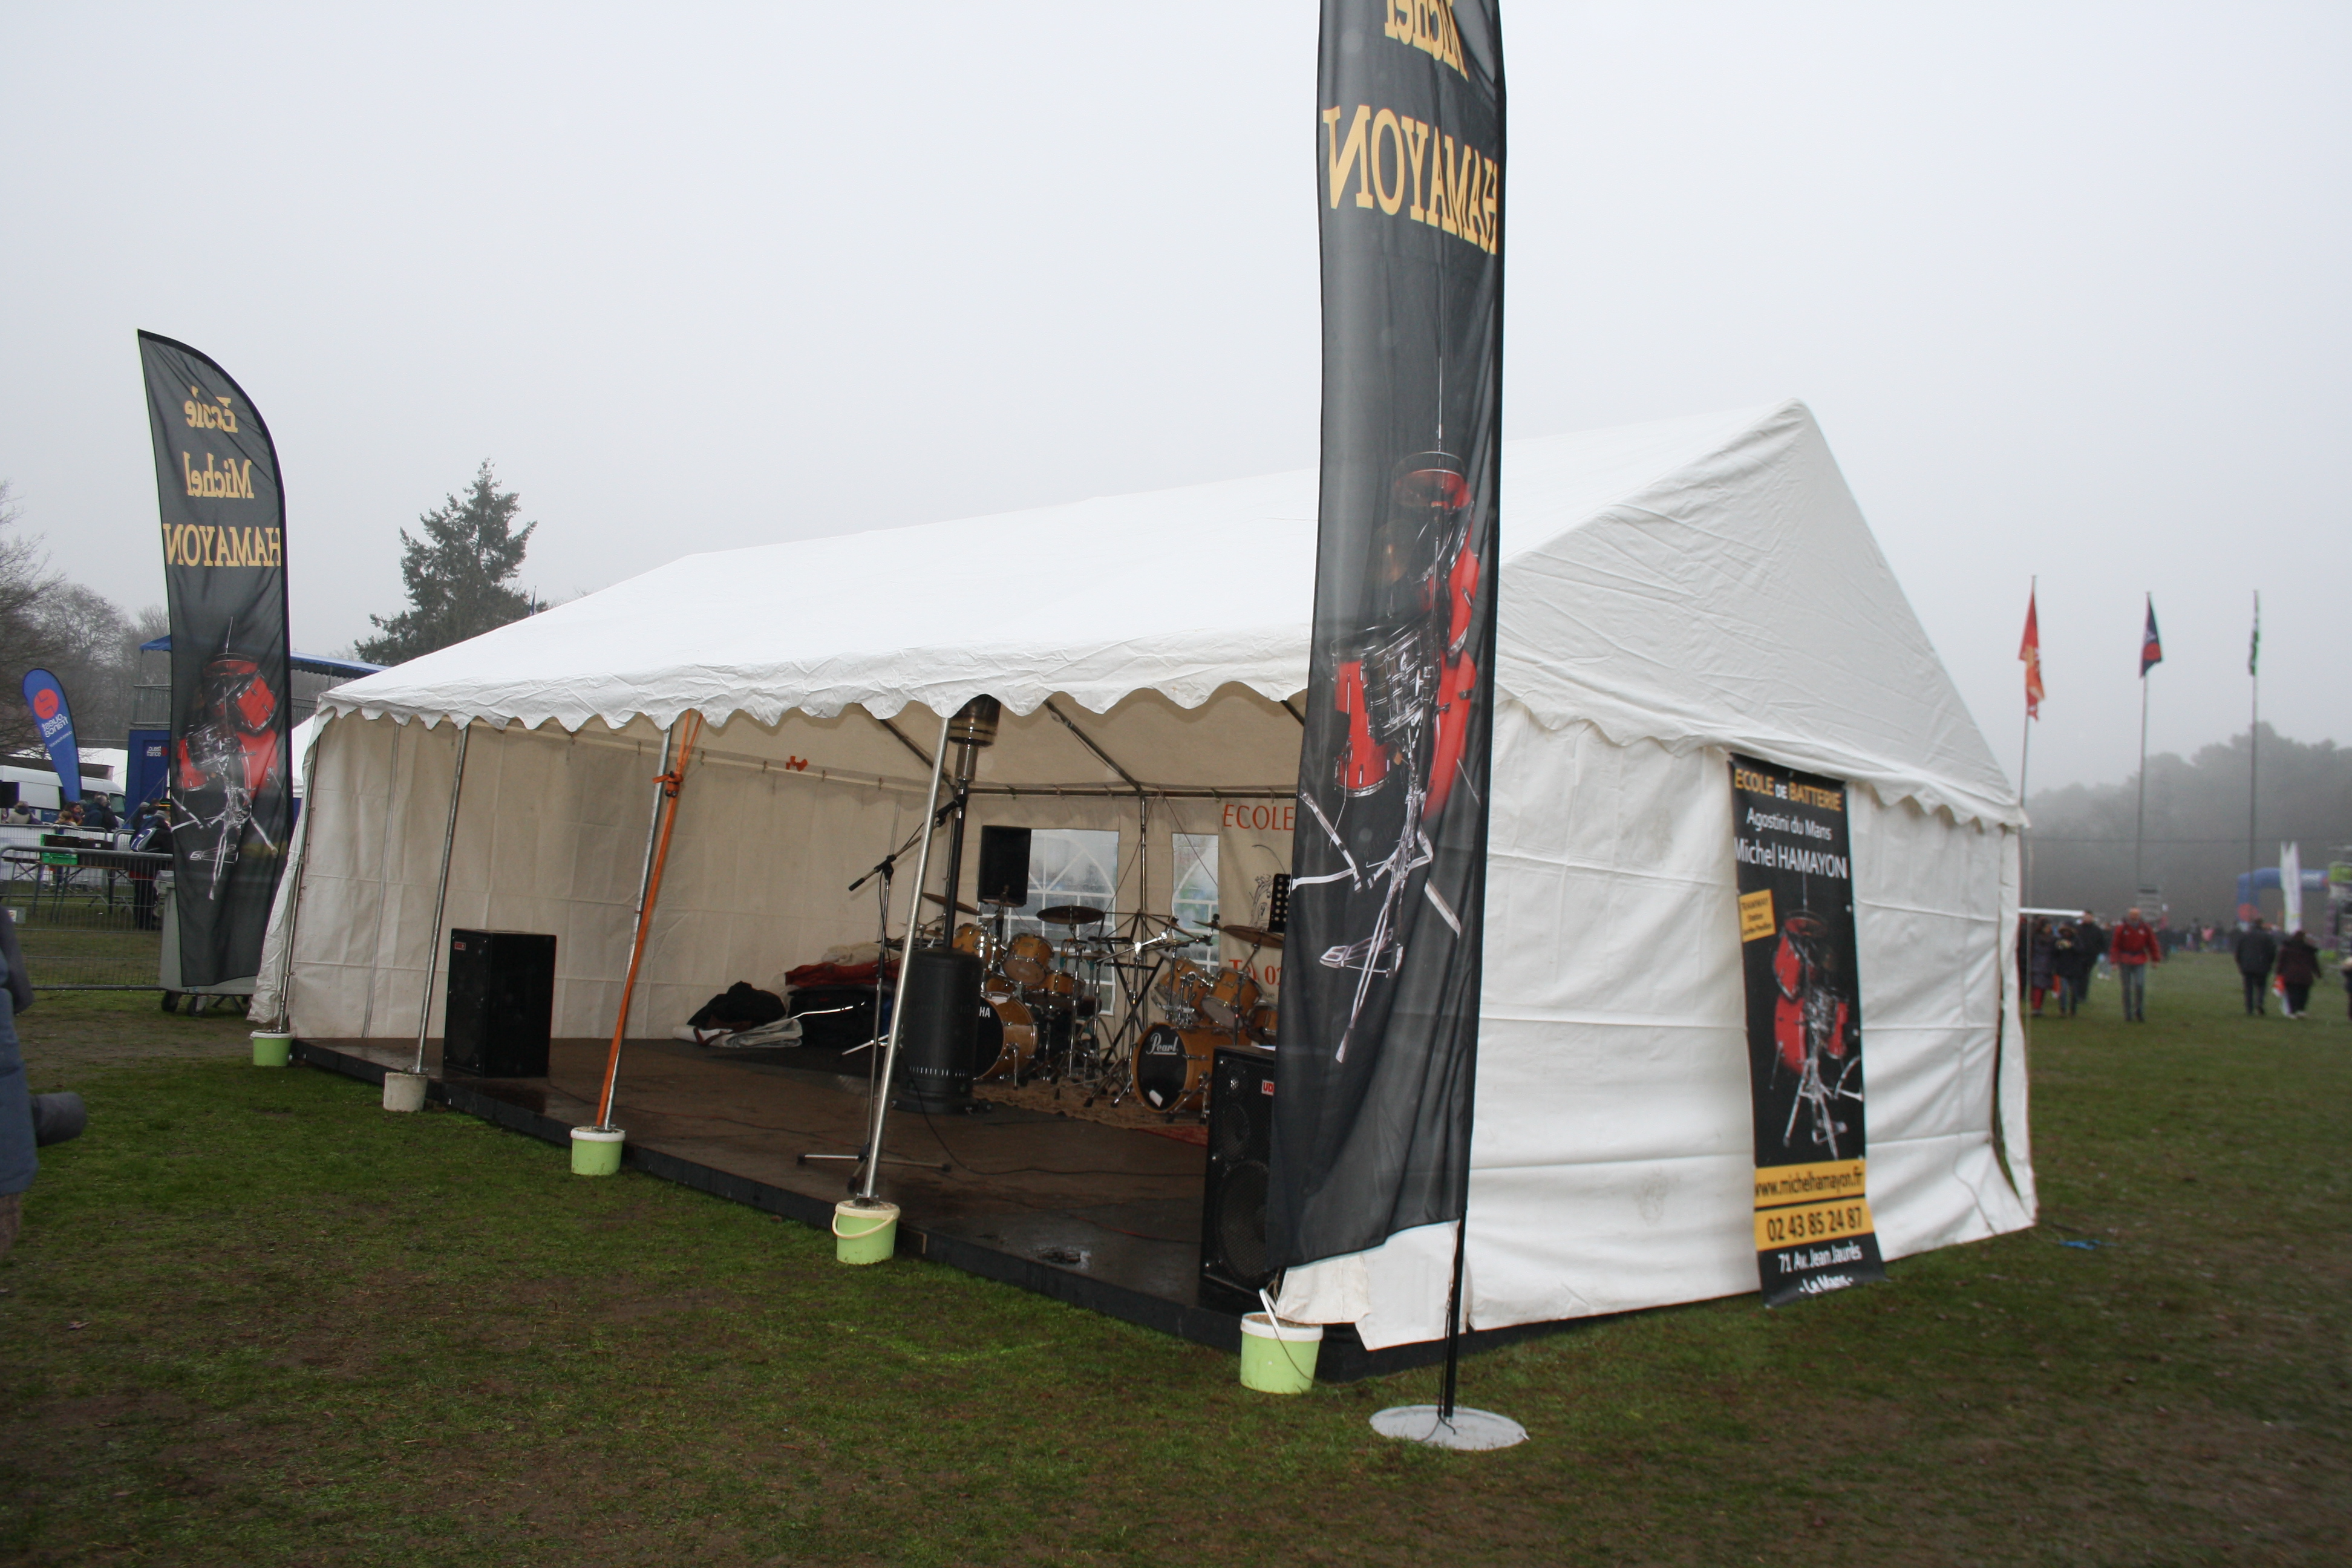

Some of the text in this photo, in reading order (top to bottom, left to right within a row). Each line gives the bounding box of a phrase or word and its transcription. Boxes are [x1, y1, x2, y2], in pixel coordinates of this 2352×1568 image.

[1734, 768, 1774, 797] ECOLE
[1789, 782, 1843, 812] BATTERIE
[1223, 804, 1295, 831] ECOLE
[1746, 807, 1832, 841] Agostini du Mans
[1734, 837, 1847, 879] Michel HAMAYON
[1146, 1033, 1178, 1055] Pearl
[1766, 1207, 1863, 1242] 02 43 85 24 87
